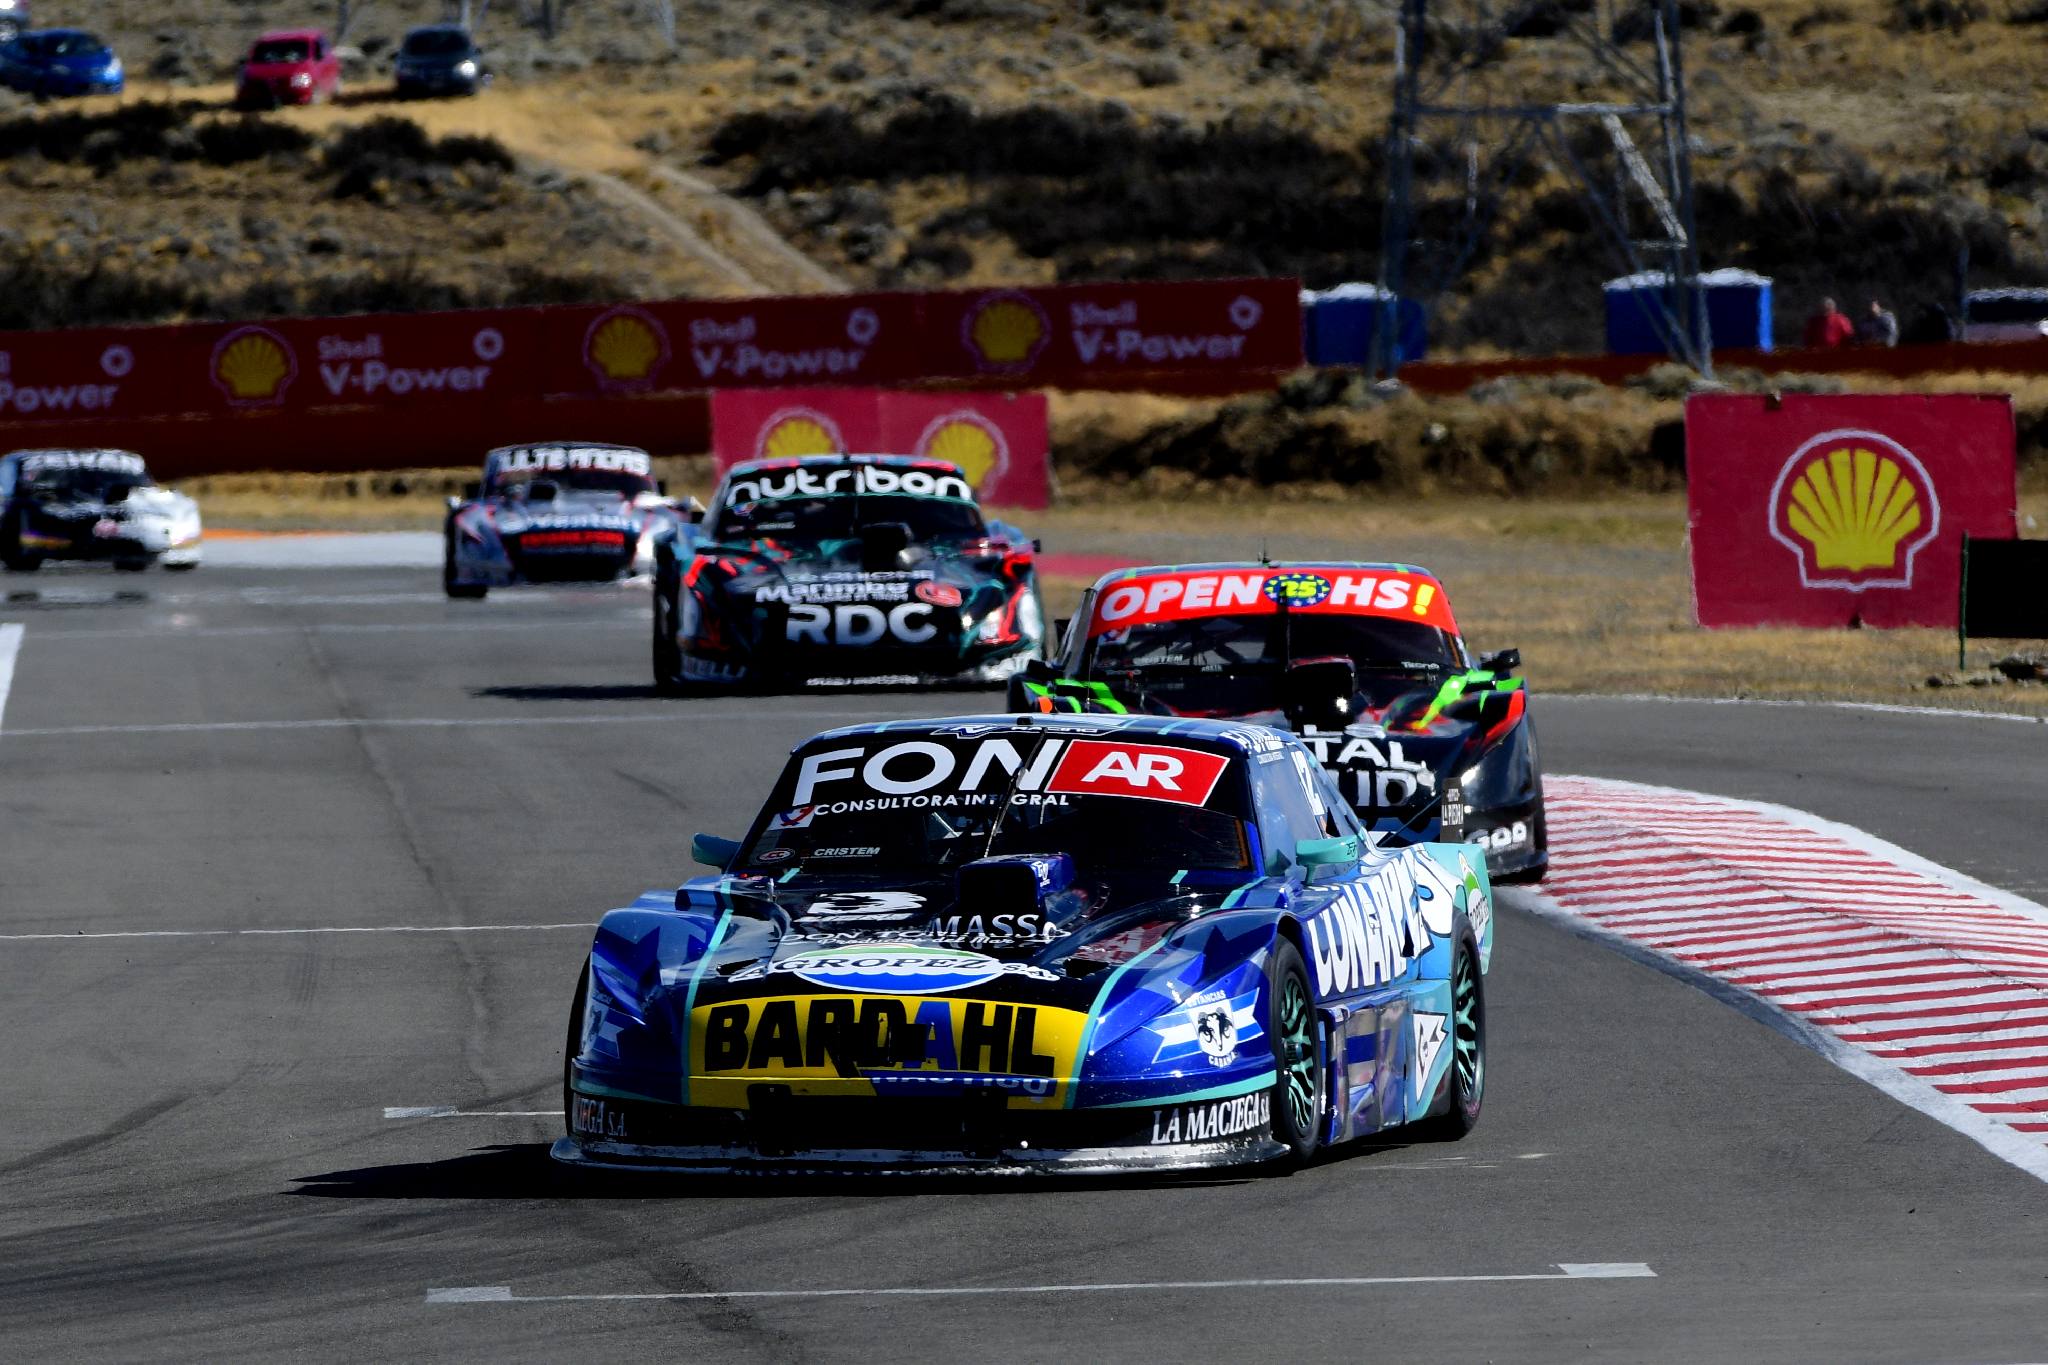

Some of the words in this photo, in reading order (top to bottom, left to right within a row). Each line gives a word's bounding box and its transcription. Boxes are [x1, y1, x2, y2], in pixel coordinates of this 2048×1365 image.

[319, 361, 490, 395] V-Power
[729, 466, 972, 504] nutribon
[1101, 576, 1264, 621] OPEN
[1329, 576, 1435, 615] HS!
[786, 602, 937, 644] RDC
[792, 741, 1065, 807] FON
[1082, 751, 1184, 791] AR
[814, 795, 957, 816] CONSULTORA
[964, 794, 1069, 806] INTGRAL
[814, 847, 880, 856] CRISTEM
[705, 998, 1055, 1079] BARDAHL
[1151, 1108, 1181, 1145] LA
[1185, 1091, 1260, 1142] MACIEGA
